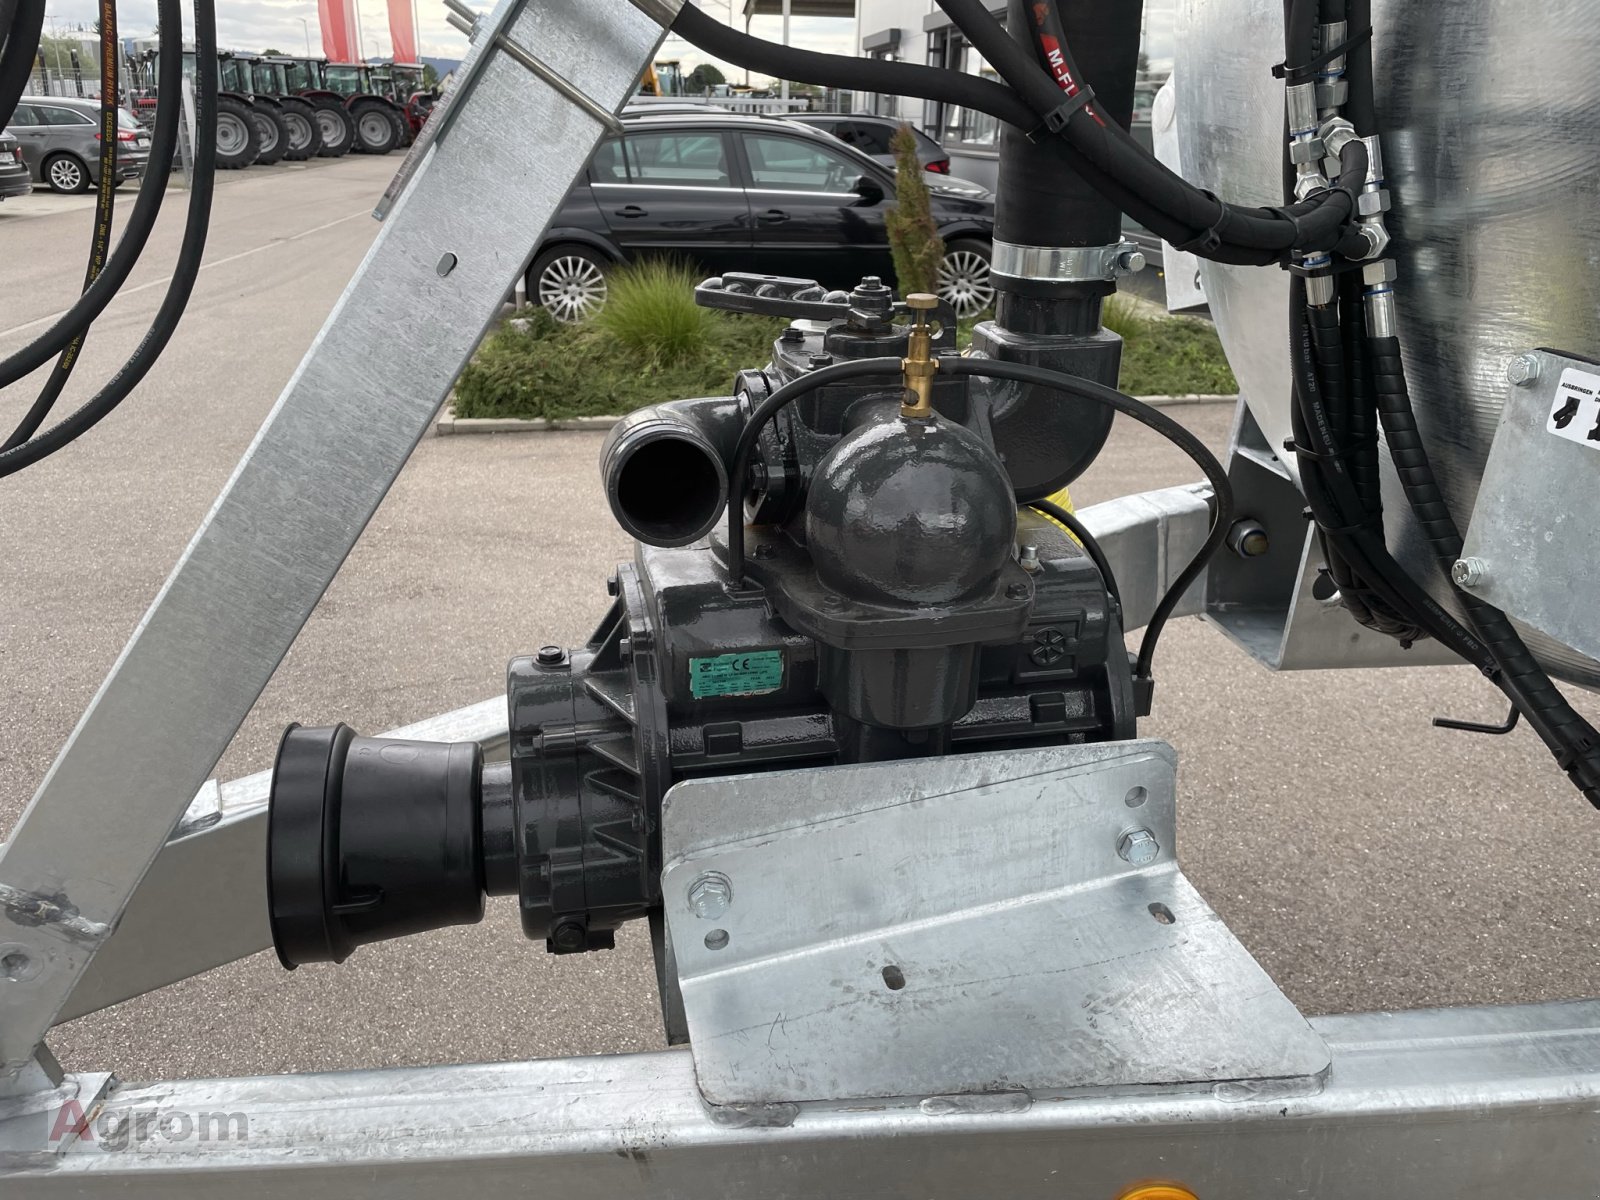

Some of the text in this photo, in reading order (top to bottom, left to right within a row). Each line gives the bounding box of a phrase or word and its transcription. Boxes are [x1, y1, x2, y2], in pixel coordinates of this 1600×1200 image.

[104, 2, 113, 36] BALPAC
[106, 41, 114, 79] PREMIUM
[1561, 382, 1594, 396] AUSBRINGEN
